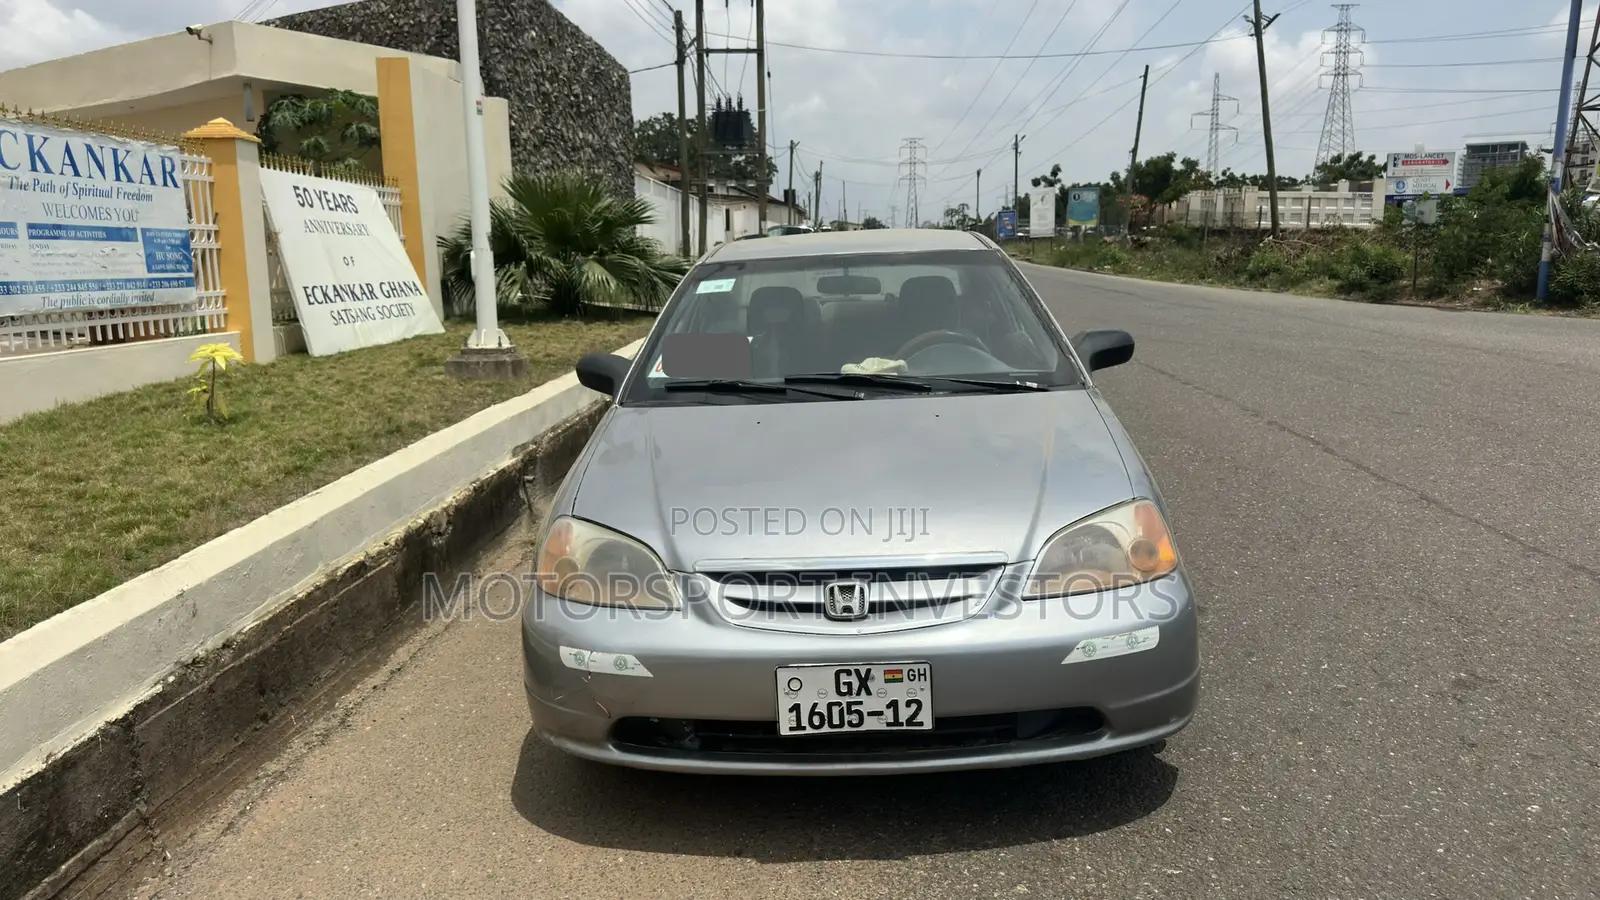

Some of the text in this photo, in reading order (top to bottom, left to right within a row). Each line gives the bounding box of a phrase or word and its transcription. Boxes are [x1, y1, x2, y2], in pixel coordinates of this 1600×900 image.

[8, 175, 153, 202] The Path of Spiritual Freedom
[293, 185, 359, 214] 50 YEARS
[42, 202, 140, 222] WELCOMES YOU
[0, 227, 18, 235] OURS
[303, 219, 370, 236] ANNIVERSARY
[41, 291, 155, 310] The public is cordially invited
[303, 280, 423, 306] ECKANKAR GHANA
[330, 303, 416, 326] SATSANG SOCIETY
[834, 668, 873, 697] GX
[907, 668, 927, 682] GH
[788, 698, 924, 732] 1605-12
